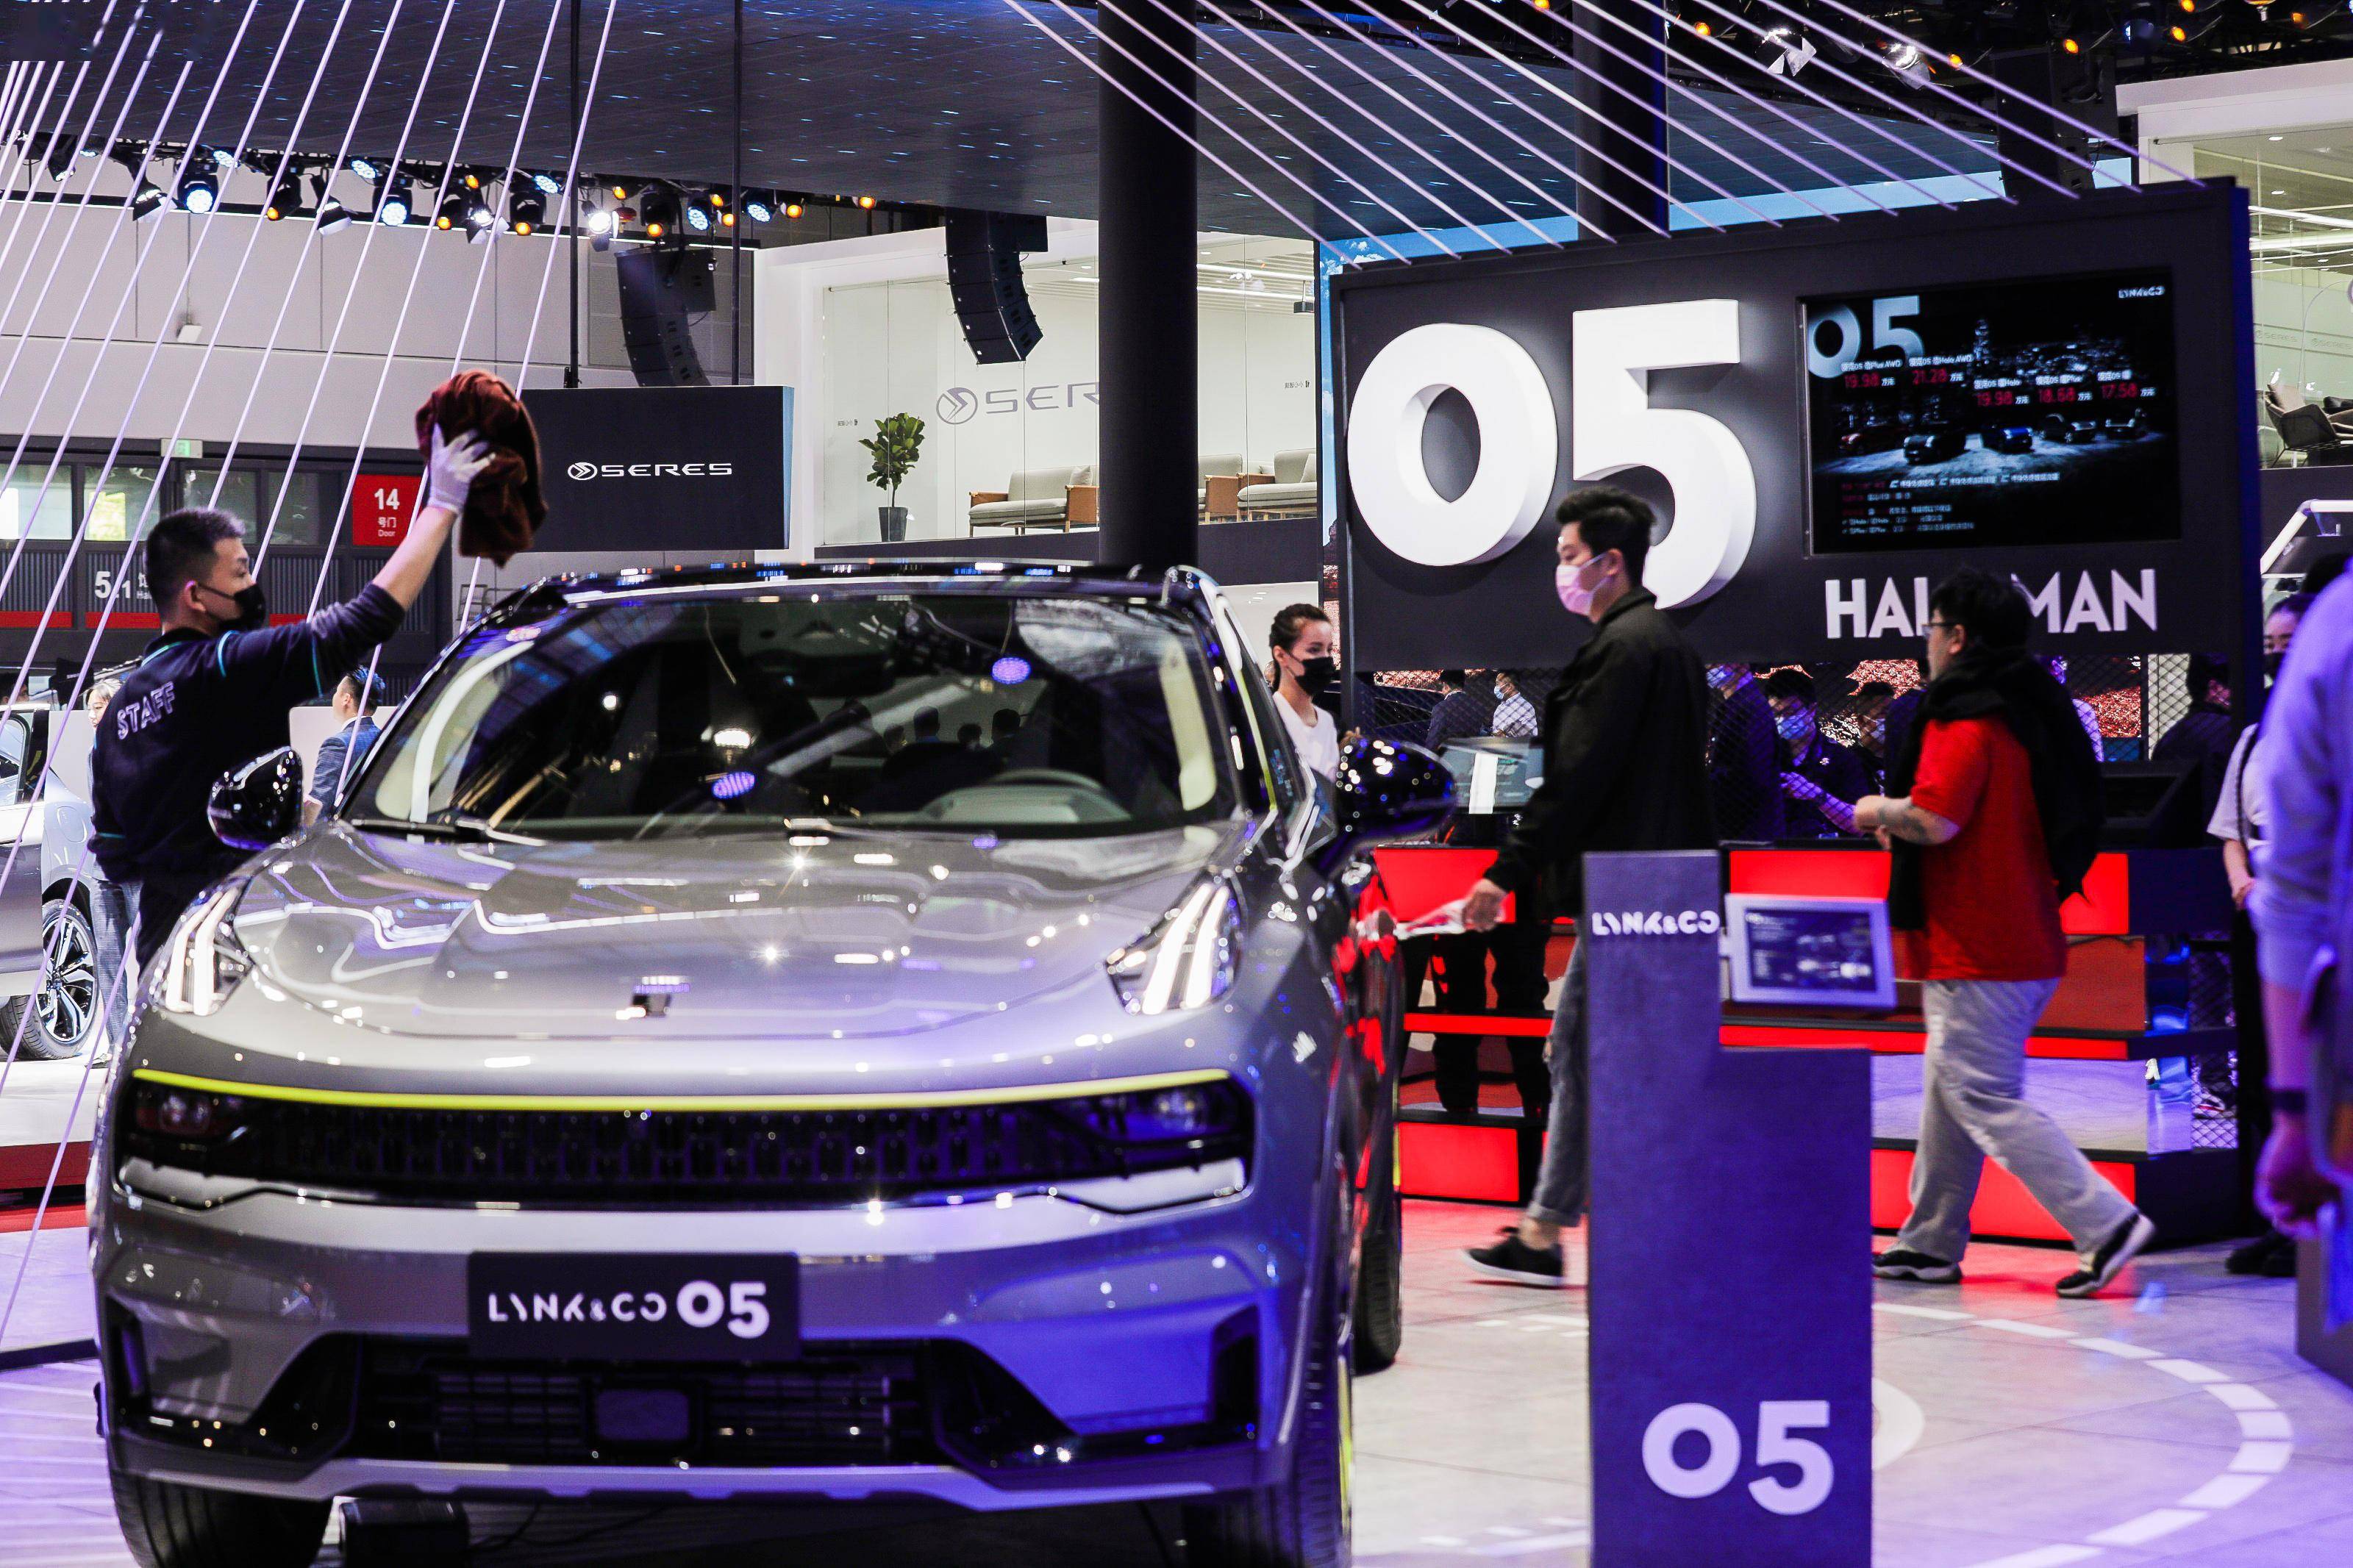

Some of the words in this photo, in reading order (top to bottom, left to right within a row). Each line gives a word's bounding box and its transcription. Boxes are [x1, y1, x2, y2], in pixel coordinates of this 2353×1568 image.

[1808, 295, 1925, 379] 05
[985, 382, 1100, 415] SER
[601, 462, 733, 478] SERES
[1348, 298, 1757, 610] 05
[374, 488, 400, 510] 14
[377, 529, 396, 537] Door
[378, 517, 397, 529] 号门
[117, 681, 176, 740] STAFF
[676, 1279, 771, 1340] 05
[1641, 1399, 1835, 1517] 05
